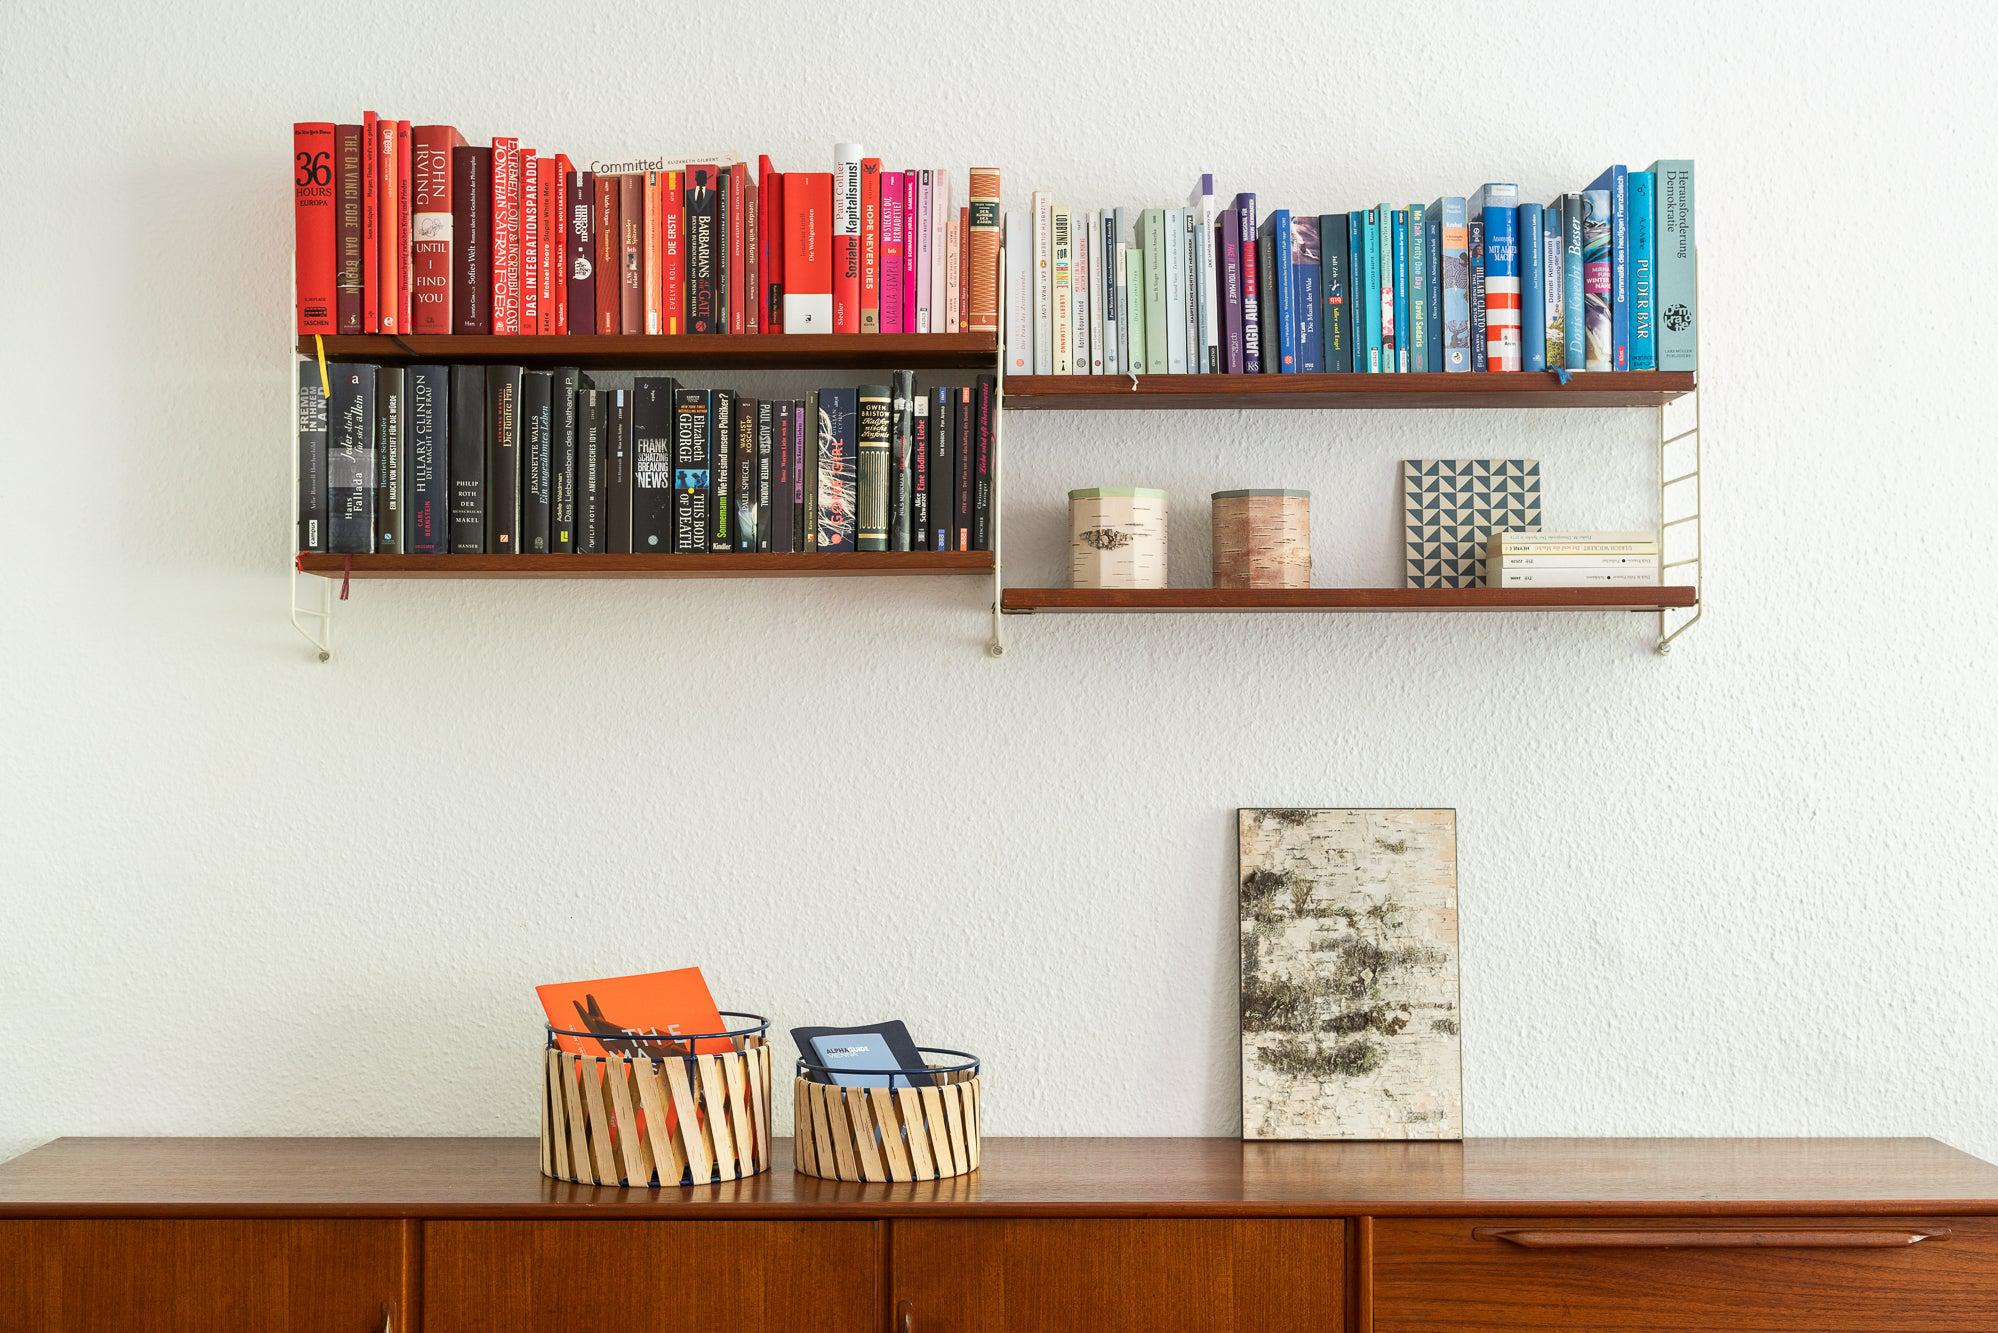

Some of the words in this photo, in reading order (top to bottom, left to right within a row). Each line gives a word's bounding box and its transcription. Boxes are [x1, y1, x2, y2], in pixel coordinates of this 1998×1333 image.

[345, 135, 357, 152] THE
[296, 152, 332, 186] 36
[345, 157, 358, 170] DA
[417, 143, 429, 205] IRVING
[430, 150, 446, 197] JOHN
[495, 140, 506, 208] JONATHAN
[507, 140, 518, 199] EXTREMELY
[591, 156, 664, 174] Committed
[296, 188, 332, 196] HOURS
[345, 172, 358, 199] VINCI
[846, 162, 859, 233] Kapitalismus!
[345, 203, 358, 227] CODE
[1666, 170, 1677, 233] Demokratie
[1677, 170, 1689, 258] Herausforderung
[507, 202, 519, 232] LOUD
[526, 154, 537, 288] INTEGRATIONSPARADOX
[668, 214, 677, 239] ERSTE
[1414, 210, 1422, 222] Me
[1414, 222, 1423, 237] Talk
[495, 210, 507, 266] SAFRAN
[508, 234, 518, 242] &
[1056, 214, 1068, 246] LOBBYING
[1569, 216, 1581, 256] Besser
[1618, 218, 1626, 249] heutigen
[345, 237, 358, 255] DAN
[416, 243, 446, 253] UNTIL
[668, 241, 677, 255] DIE
[698, 216, 711, 278] BARBARIANS
[846, 236, 858, 278] Sozialer
[866, 234, 874, 266] NEVER
[1413, 238, 1423, 260] Pretty
[345, 261, 358, 294] BROWN
[429, 260, 432, 269] I
[507, 244, 518, 297] INCREDIBLY
[1056, 262, 1068, 289] CHANGE
[1415, 261, 1423, 275] One
[1637, 259, 1649, 278] PU
[417, 277, 446, 286] FIND
[866, 268, 874, 289] DIES
[1414, 276, 1423, 290] Day
[1476, 267, 1485, 298] HILLARY
[1569, 266, 1583, 312] Knecht
[418, 293, 443, 302] YOU
[494, 270, 507, 318] FOER
[526, 295, 536, 316] DAS
[698, 291, 711, 317] GATE
[1637, 281, 1649, 309] DER
[507, 299, 518, 332] CLOSE
[1245, 298, 1258, 321] AUF
[1415, 300, 1423, 319] David
[1477, 299, 1486, 333] CLINTON
[1415, 321, 1423, 348] Sedaris
[1570, 315, 1583, 353] Doris
[1637, 312, 1650, 339] BÄR
[1246, 323, 1259, 357] JAGD
[565, 377, 573, 385] P.
[300, 386, 309, 432] FREMD
[416, 375, 425, 434] CLINTON
[719, 393, 728, 428] Politiker?
[760, 404, 770, 423] PAUL
[310, 421, 316, 431] IN
[679, 414, 691, 463] GEORGE
[694, 415, 704, 461] Elizabeth
[638, 439, 668, 452] FRANK
[760, 429, 771, 454] AUSTER
[416, 438, 426, 492] HILLARY
[540, 431, 549, 487] ungezähmtes
[831, 438, 843, 473] GIRL
[917, 441, 925, 474] tödliche
[564, 449, 573, 502] Liebesleben
[635, 472, 668, 488] NEWS
[719, 469, 728, 482] frei
[353, 472, 363, 512] Fallada
[540, 489, 548, 504] Ein
[681, 494, 689, 505] OF
[760, 481, 769, 507] JOURNAL
[831, 479, 843, 526] GONE
[694, 494, 704, 520] THIS
[717, 497, 727, 538] Sonnemann
[679, 508, 691, 549] DEATH
[693, 522, 704, 549] BODY
[621, 1024, 687, 1047] THE
